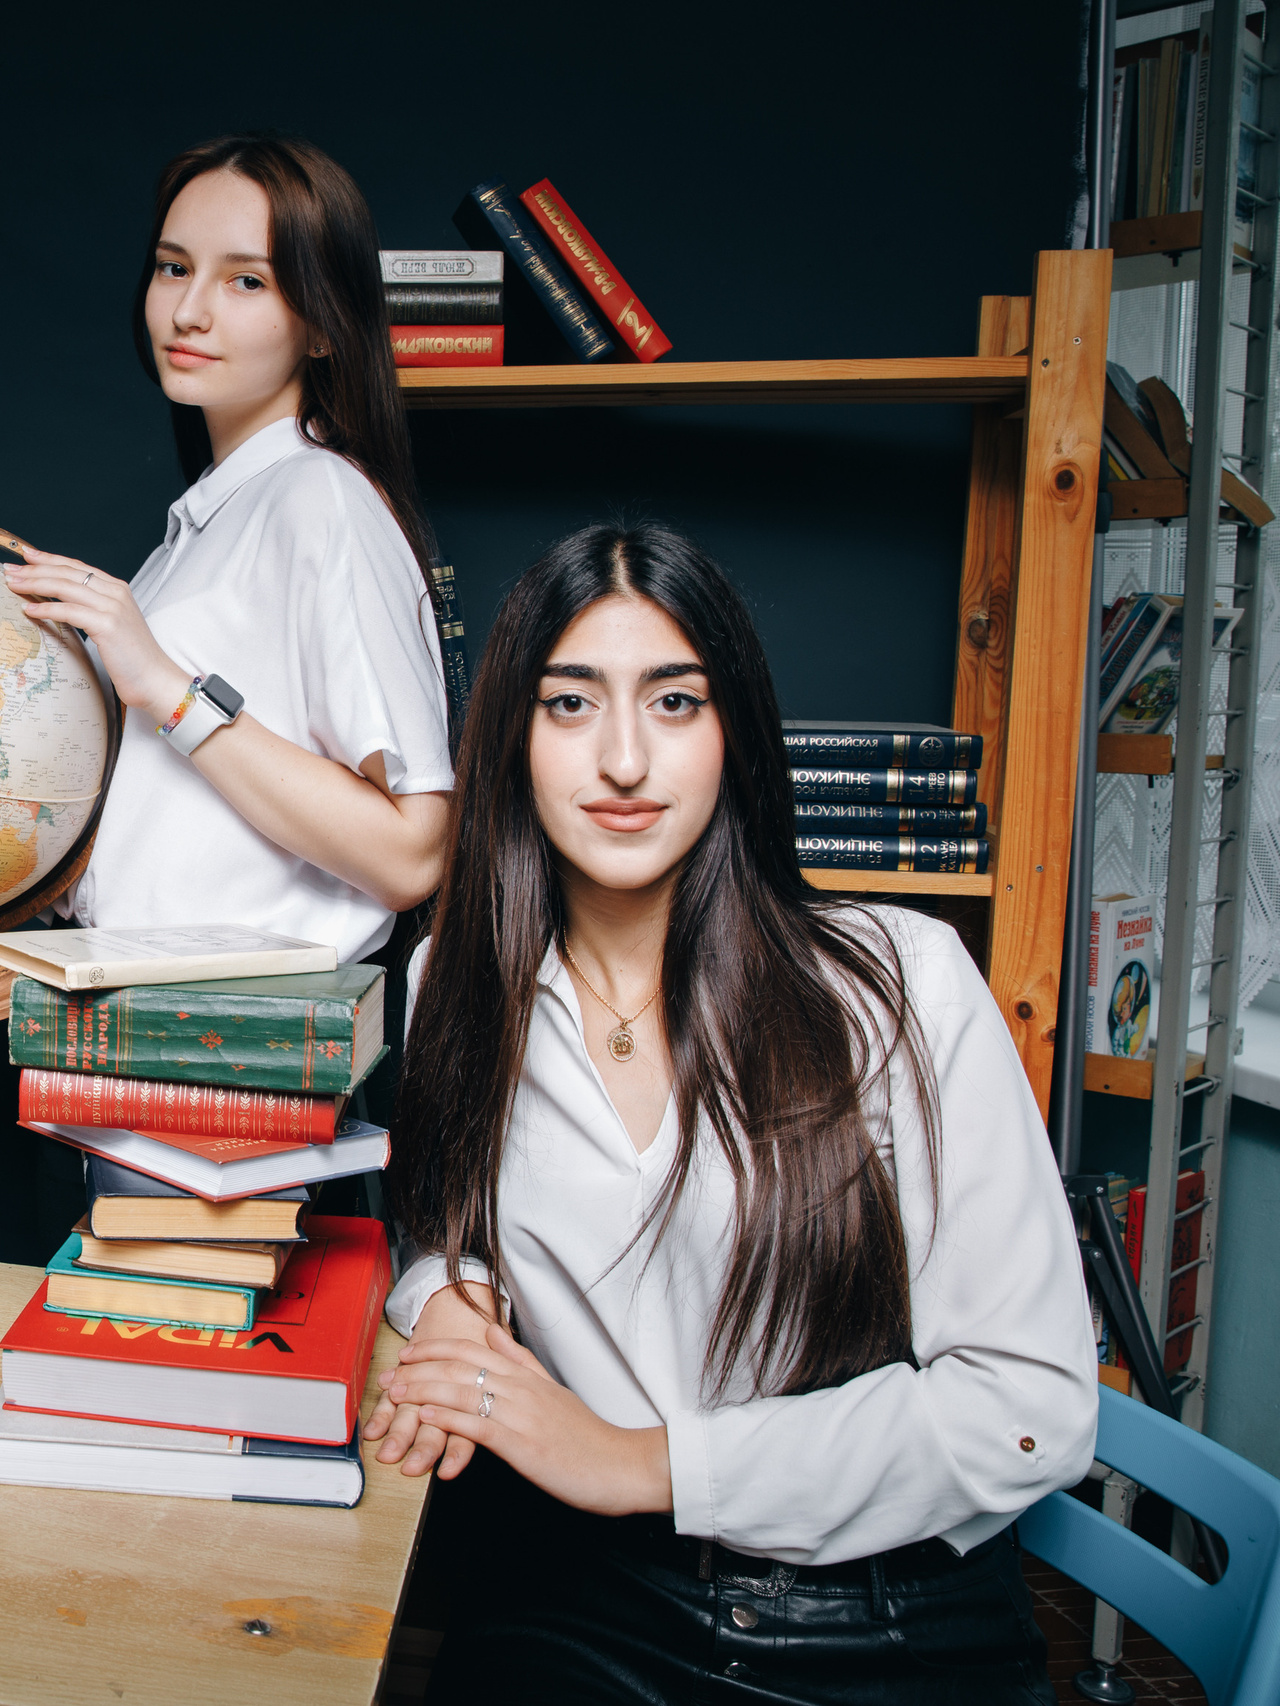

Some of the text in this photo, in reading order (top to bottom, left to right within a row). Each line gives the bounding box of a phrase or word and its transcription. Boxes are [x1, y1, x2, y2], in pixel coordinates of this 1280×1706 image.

[1193, 58, 1210, 167] ОТЕЧЕСКАЯ ЗЕМЛЯ
[400, 261, 427, 274] ВЕРН
[809, 736, 879, 748] РОССИЙСКАЯ
[795, 838, 884, 853] ЭНЦИКЛОП
[920, 844, 938, 864] 12
[65, 995, 80, 1068] ПОСЛОВИЦЫ
[82, 995, 93, 1070] РУССКОГО
[96, 1001, 111, 1067] НАРОДА
[93, 1074, 103, 1125] ПУШКИН
